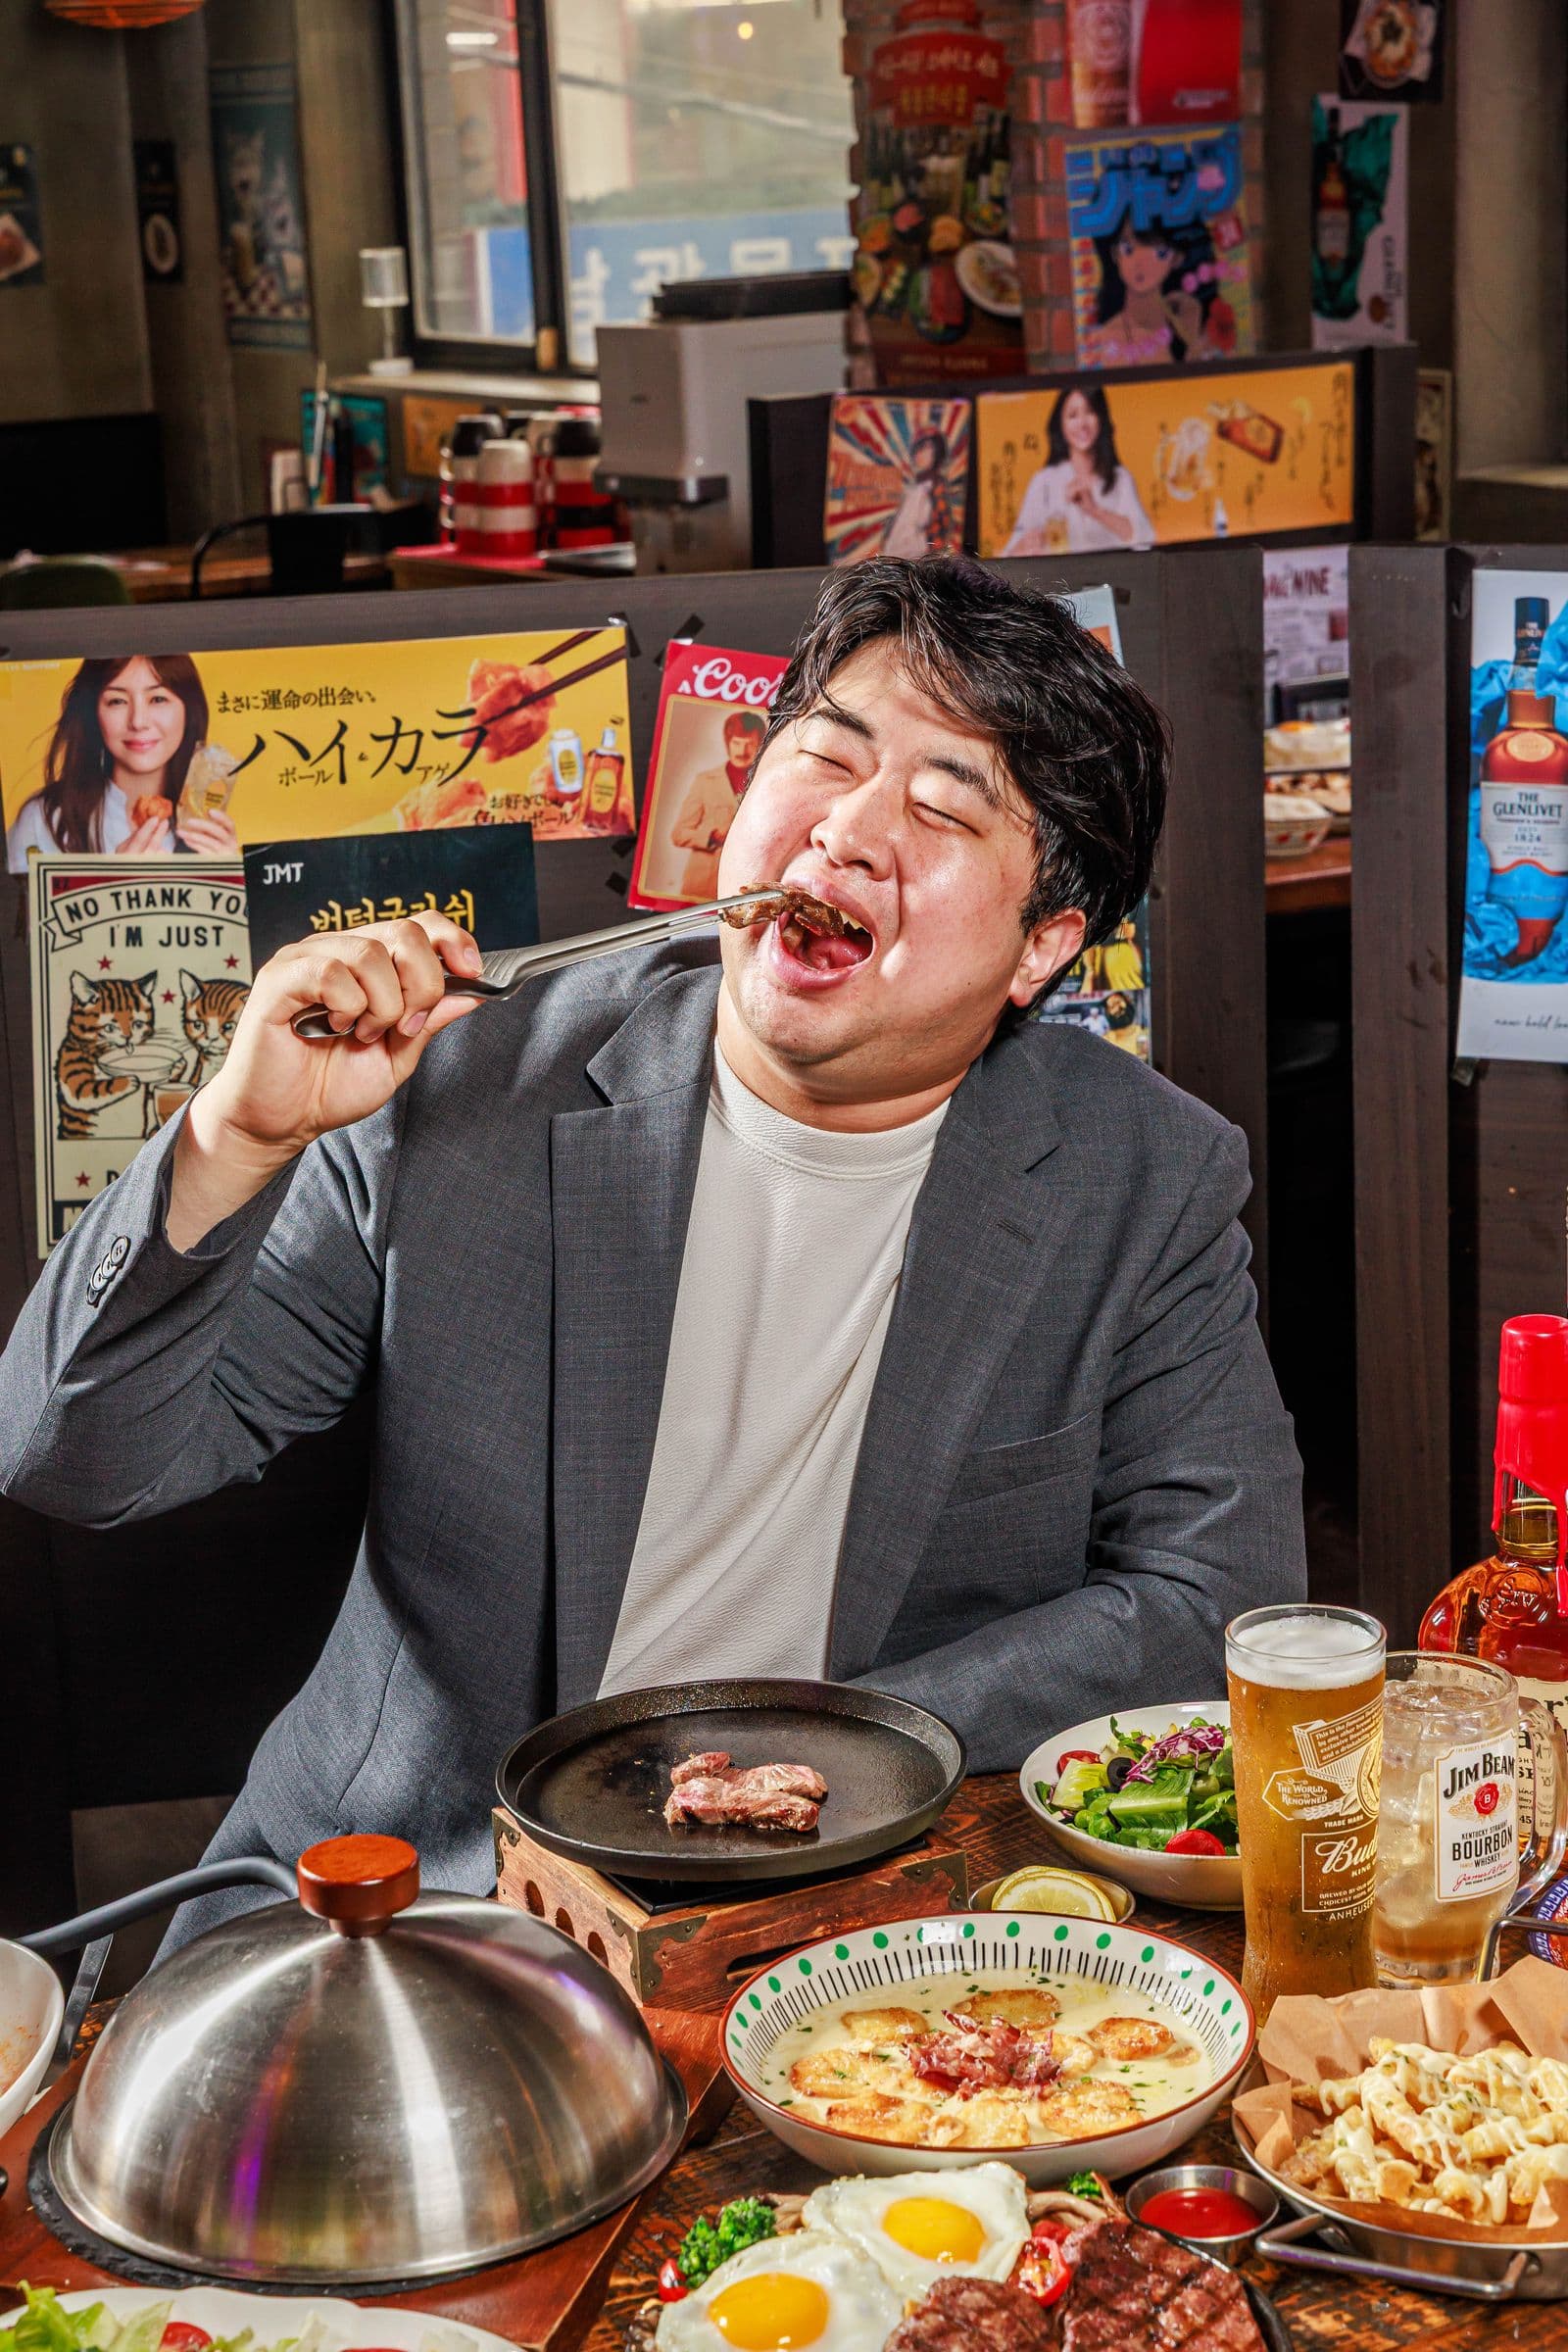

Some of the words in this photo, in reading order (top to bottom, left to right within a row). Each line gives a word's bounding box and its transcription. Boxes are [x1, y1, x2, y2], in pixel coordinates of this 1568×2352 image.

[692, 658, 784, 707] Coor
[1518, 792, 1540, 803] THE
[1493, 803, 1563, 817] GLENLIVET
[263, 862, 304, 885] JMT
[65, 897, 99, 923] NO
[110, 888, 193, 910] THANK
[210, 892, 250, 918] YO
[110, 924, 143, 948] I'M
[159, 926, 224, 947] JUST
[1443, 1762, 1481, 1800] JIM
[1482, 1751, 1515, 1779] BEAM
[1484, 1793, 1492, 1804] B
[1324, 1819, 1347, 1829] TRADE
[1347, 1815, 1364, 1825] MARK
[1461, 1828, 1489, 1840] KENTUCKY
[1489, 1819, 1508, 1834] STRAIGHT
[1452, 1824, 1513, 1861] BOURBON
[1350, 1863, 1371, 1878] KING
[1474, 1852, 1501, 1869] WHISKEY
